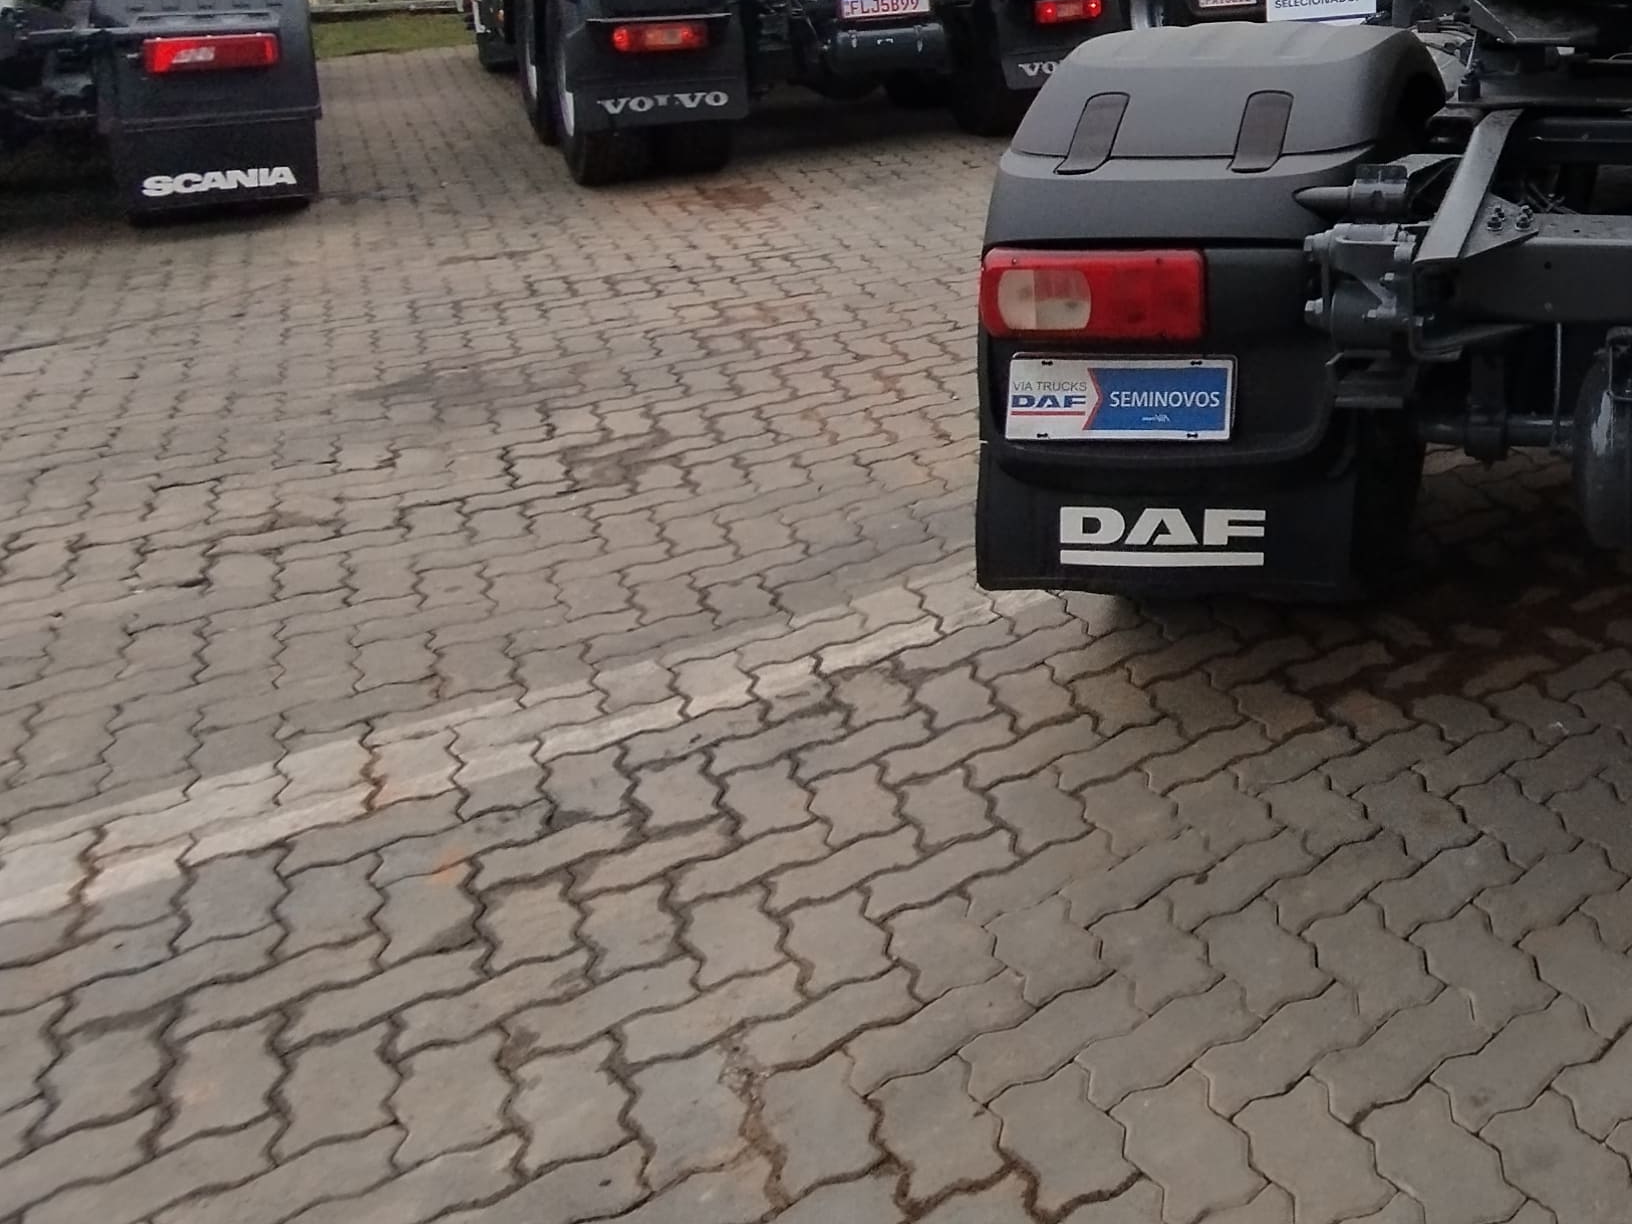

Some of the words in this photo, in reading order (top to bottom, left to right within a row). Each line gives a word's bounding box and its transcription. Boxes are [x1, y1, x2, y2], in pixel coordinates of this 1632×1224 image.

[141, 166, 297, 197] SCANIA
[1013, 382, 1033, 391] VIA
[1036, 381, 1087, 392] TRUCKS
[1011, 394, 1086, 408] DAF
[1109, 390, 1220, 409] SEMINOVOS
[1060, 506, 1266, 545] DAF
